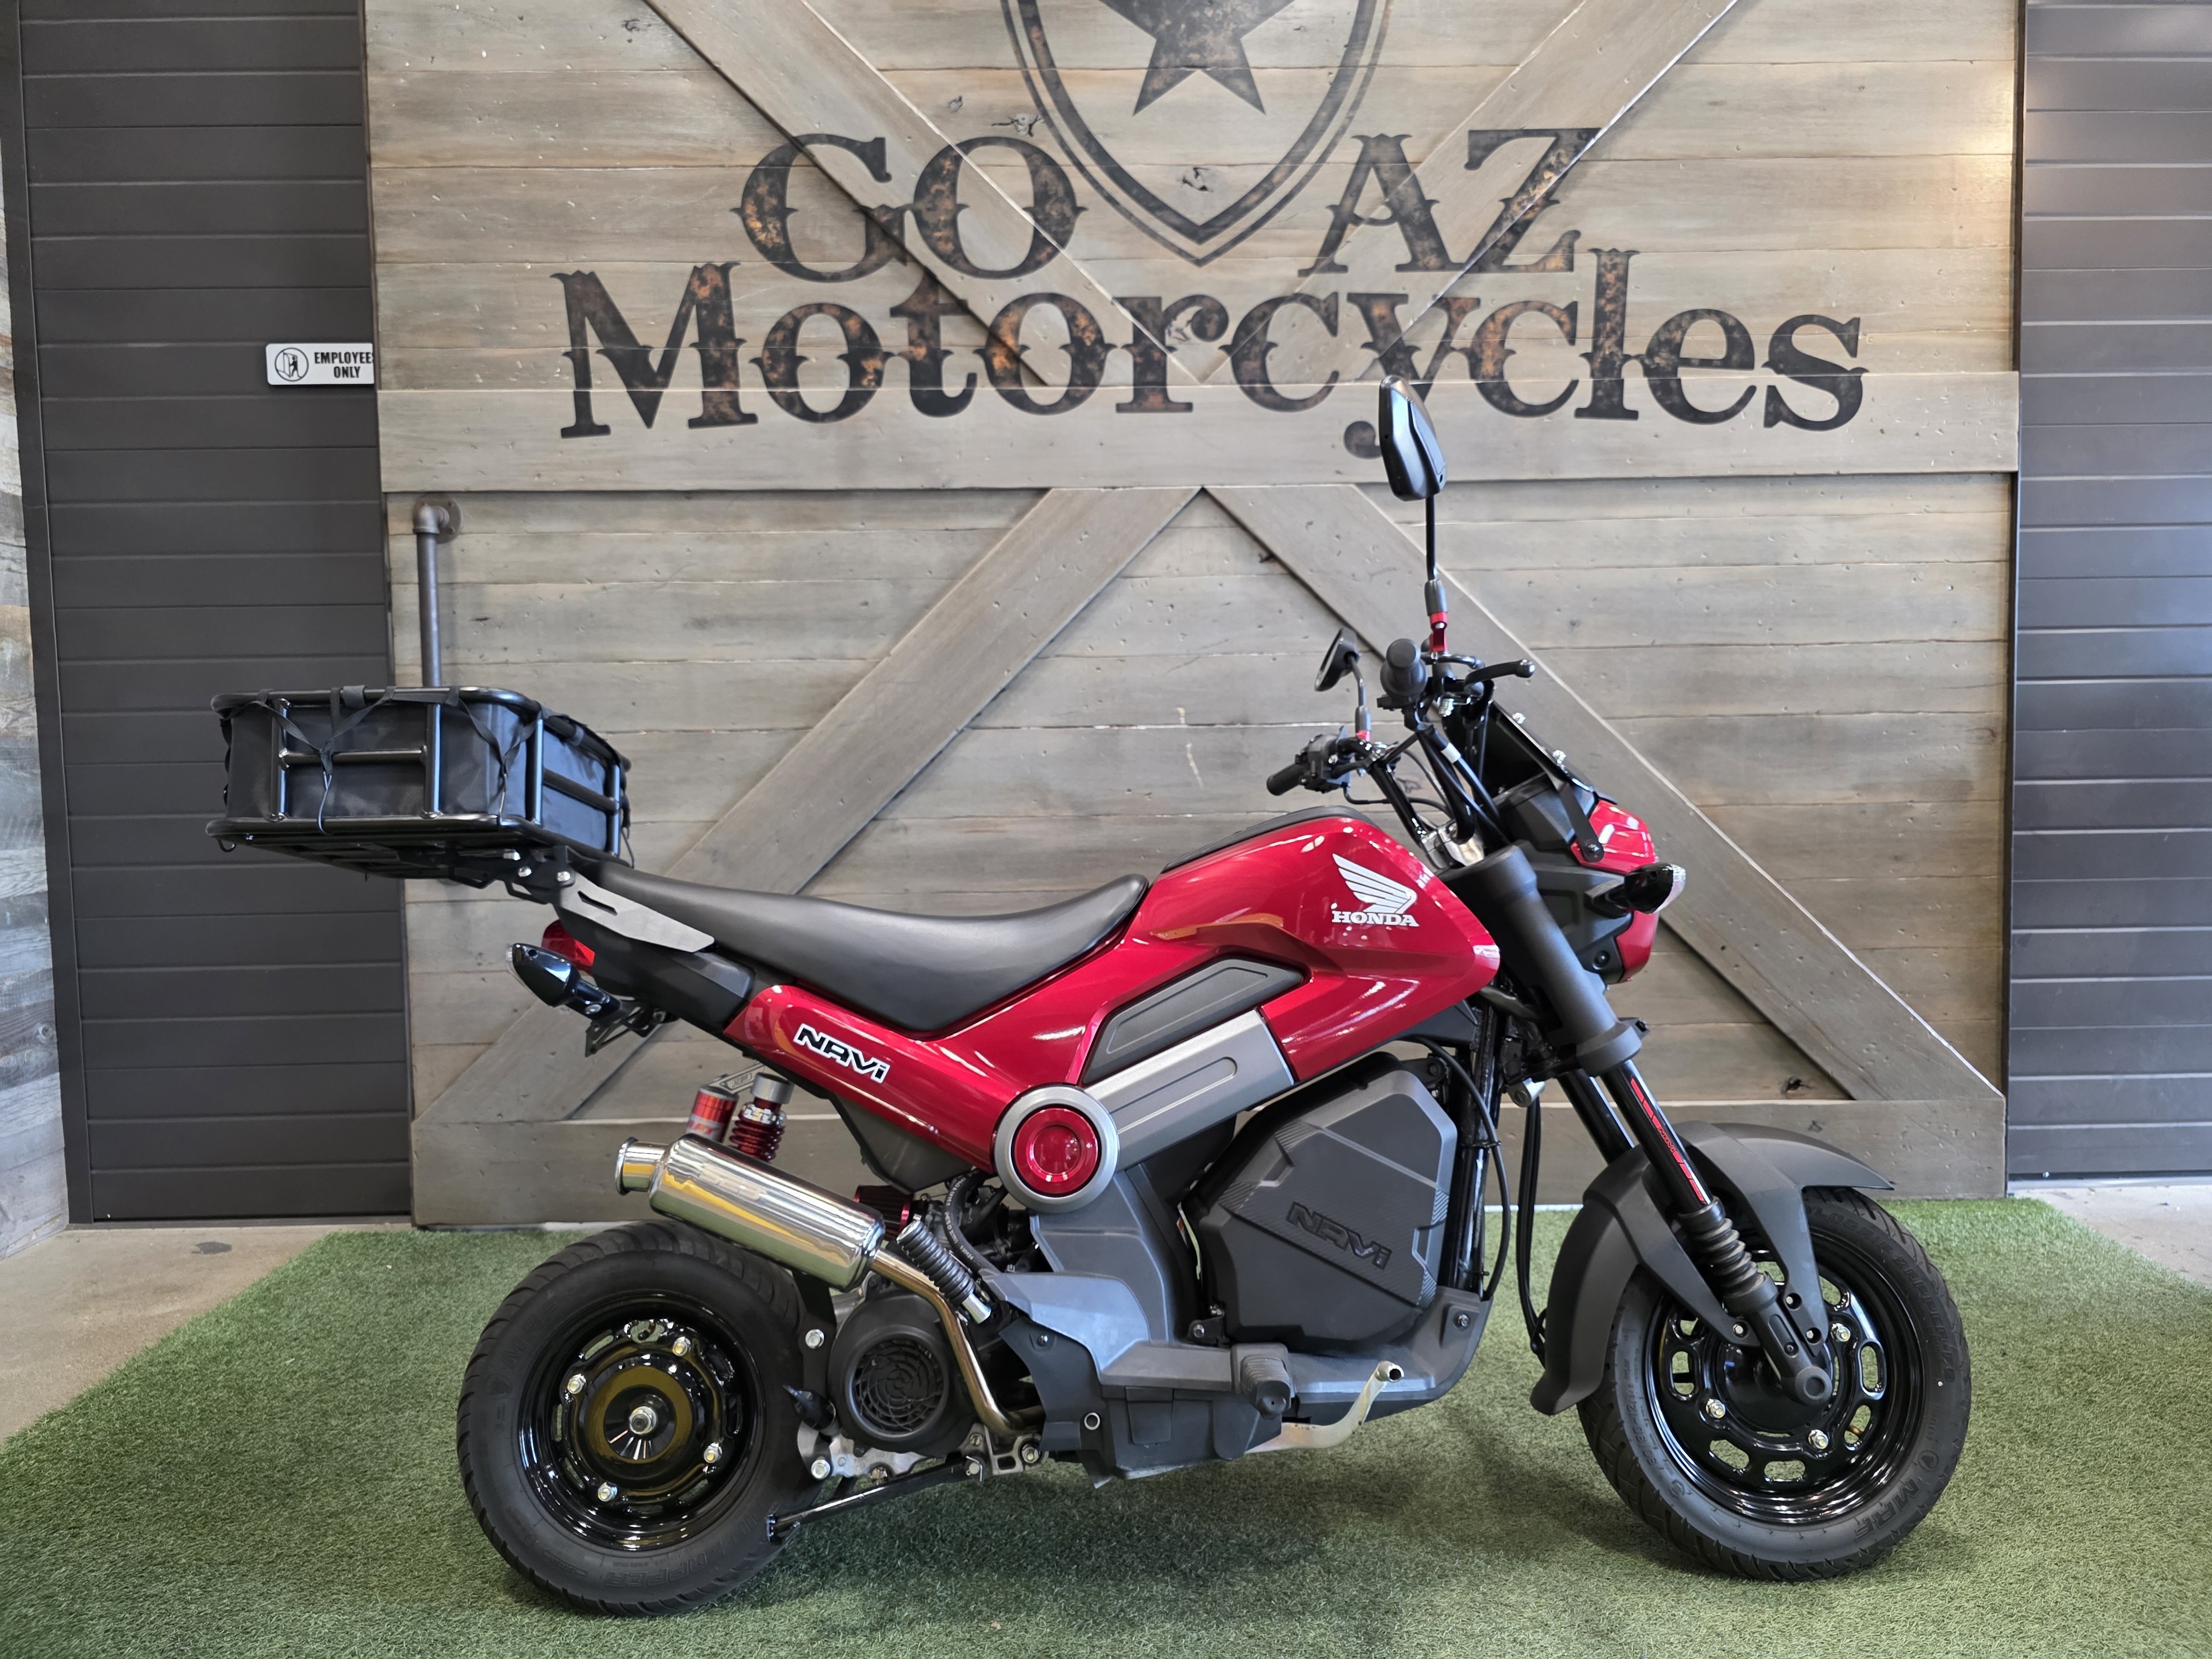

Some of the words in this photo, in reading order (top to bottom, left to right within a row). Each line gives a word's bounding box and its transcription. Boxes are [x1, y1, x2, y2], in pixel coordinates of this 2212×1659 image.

[729, 133, 1089, 281] GO
[1297, 128, 1601, 278] AZ
[314, 352, 374, 364] EMPLOYEE
[334, 366, 361, 378] ONLY
[550, 249, 1869, 458] Motorcycles
[1332, 911, 1420, 927] HONDA
[1854, 1478, 1920, 1543] MRF
